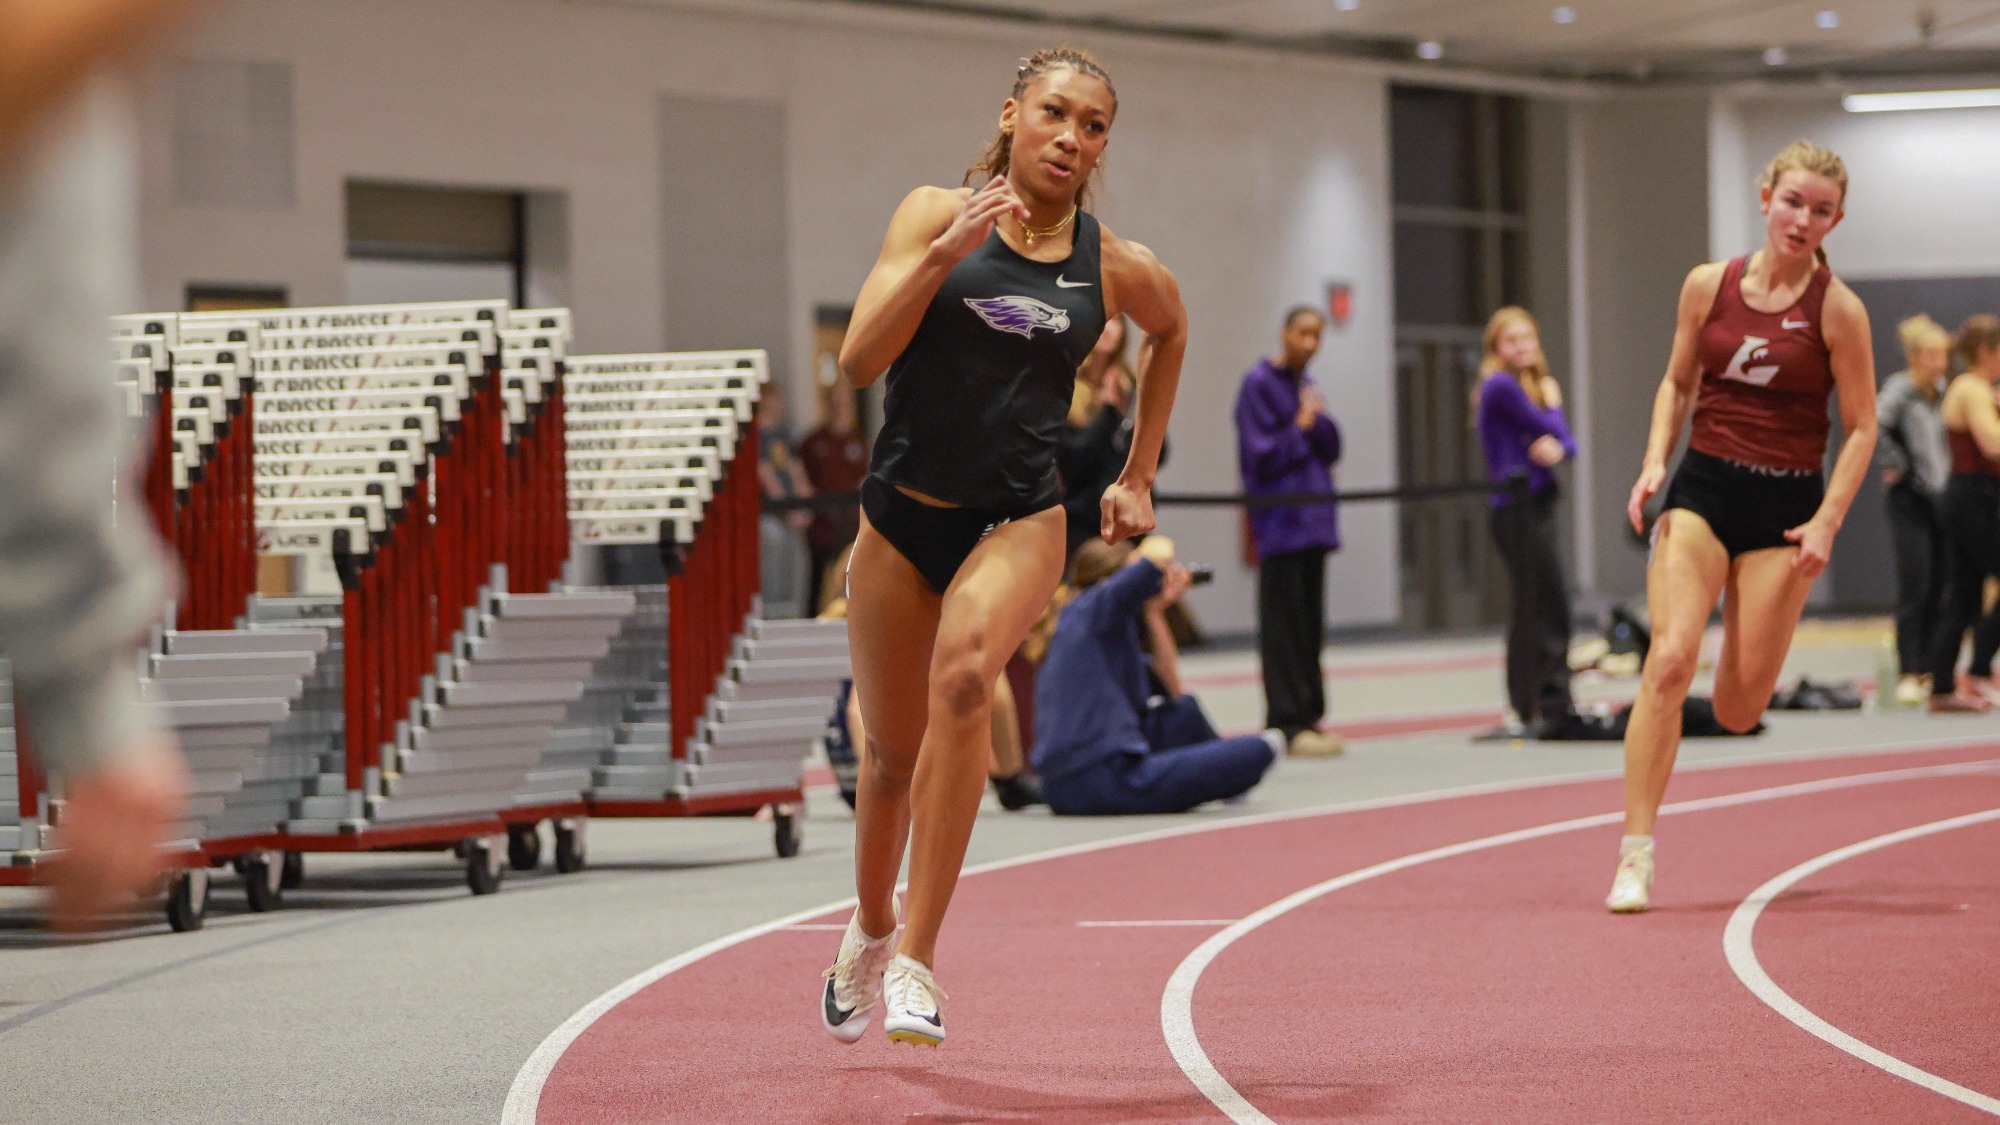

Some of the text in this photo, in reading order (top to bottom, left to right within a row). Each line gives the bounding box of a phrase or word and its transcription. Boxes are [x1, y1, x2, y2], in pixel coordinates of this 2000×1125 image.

[288, 354, 363, 370] CROSSE
[258, 418, 321, 434] ROSSE
[255, 440, 304, 454] OSSE
